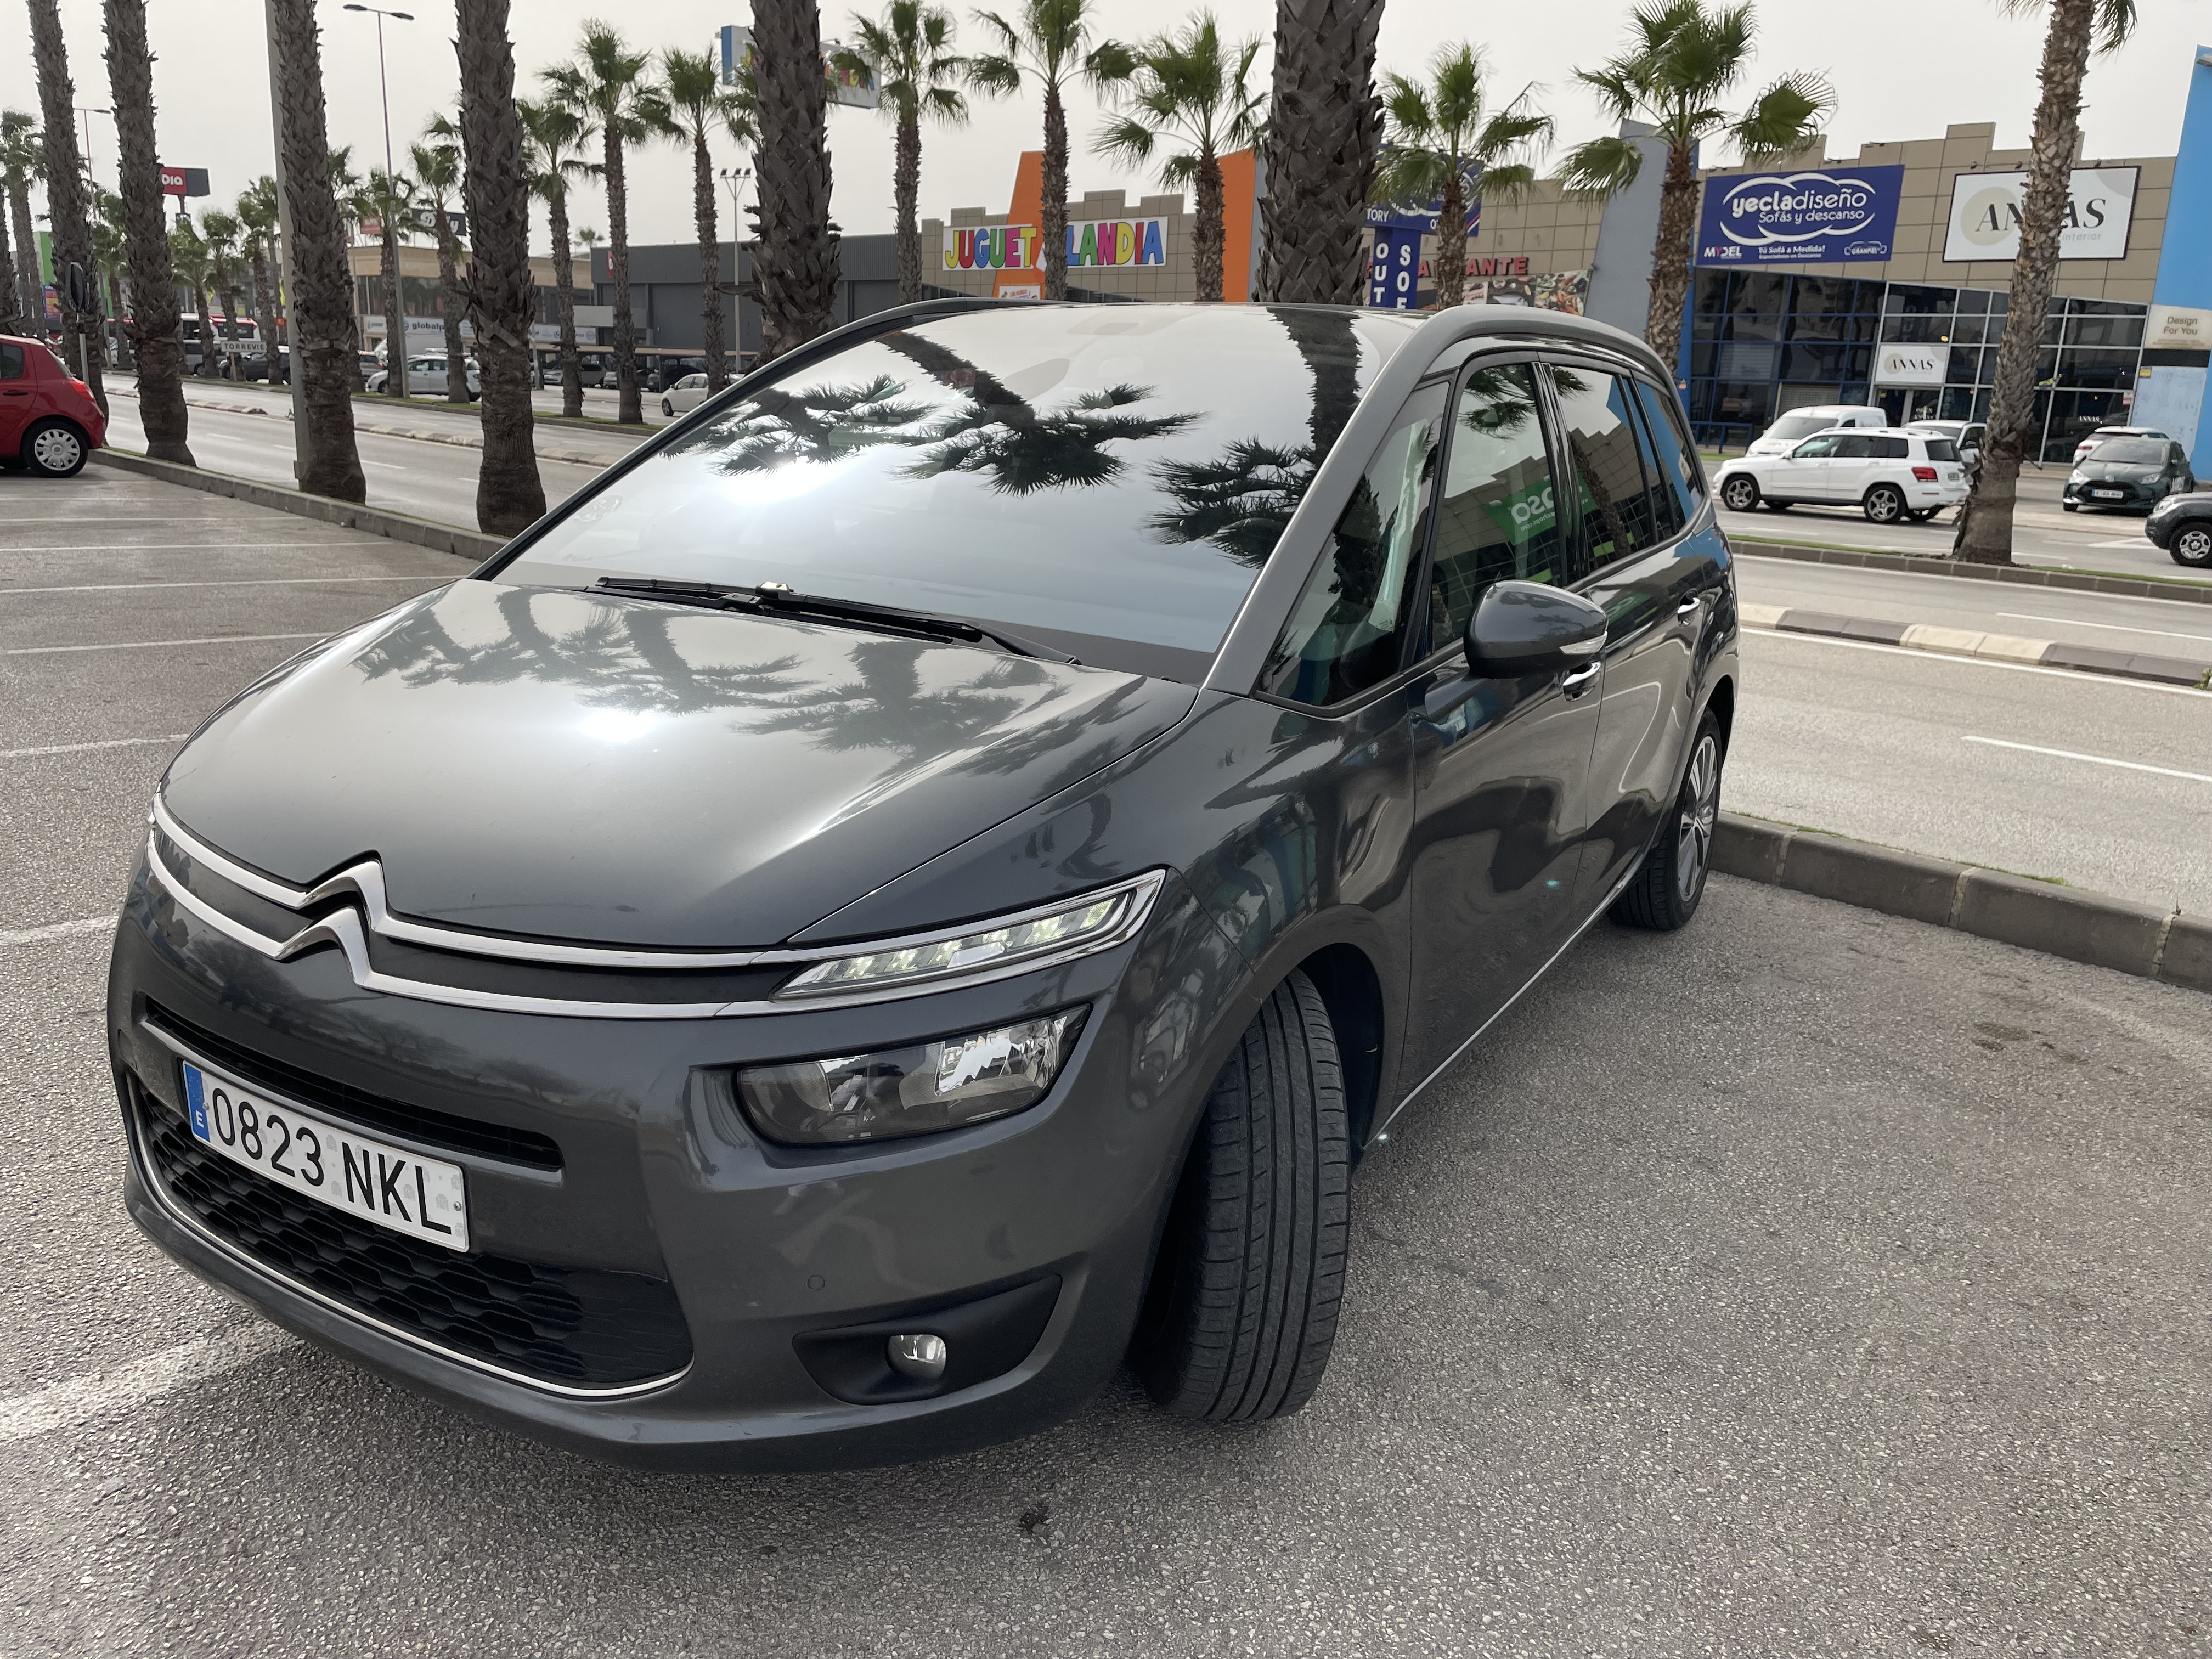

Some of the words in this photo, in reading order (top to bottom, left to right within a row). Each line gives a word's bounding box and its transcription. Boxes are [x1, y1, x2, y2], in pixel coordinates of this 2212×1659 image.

[1732, 188, 1867, 218] yecladiseño
[1367, 208, 1389, 222] TORY
[1759, 211, 1792, 223] Sofás
[1795, 212, 1803, 225] y
[1805, 210, 1865, 221] descanso
[1976, 199, 2106, 232] ANAS
[945, 222, 1164, 269] JUGUETLANDIA
[412, 322, 444, 332] globalp
[2167, 317, 2198, 326] Design
[195, 1110, 205, 1128] E
[212, 1088, 325, 1186] 0823
[342, 1141, 452, 1235] NKL
